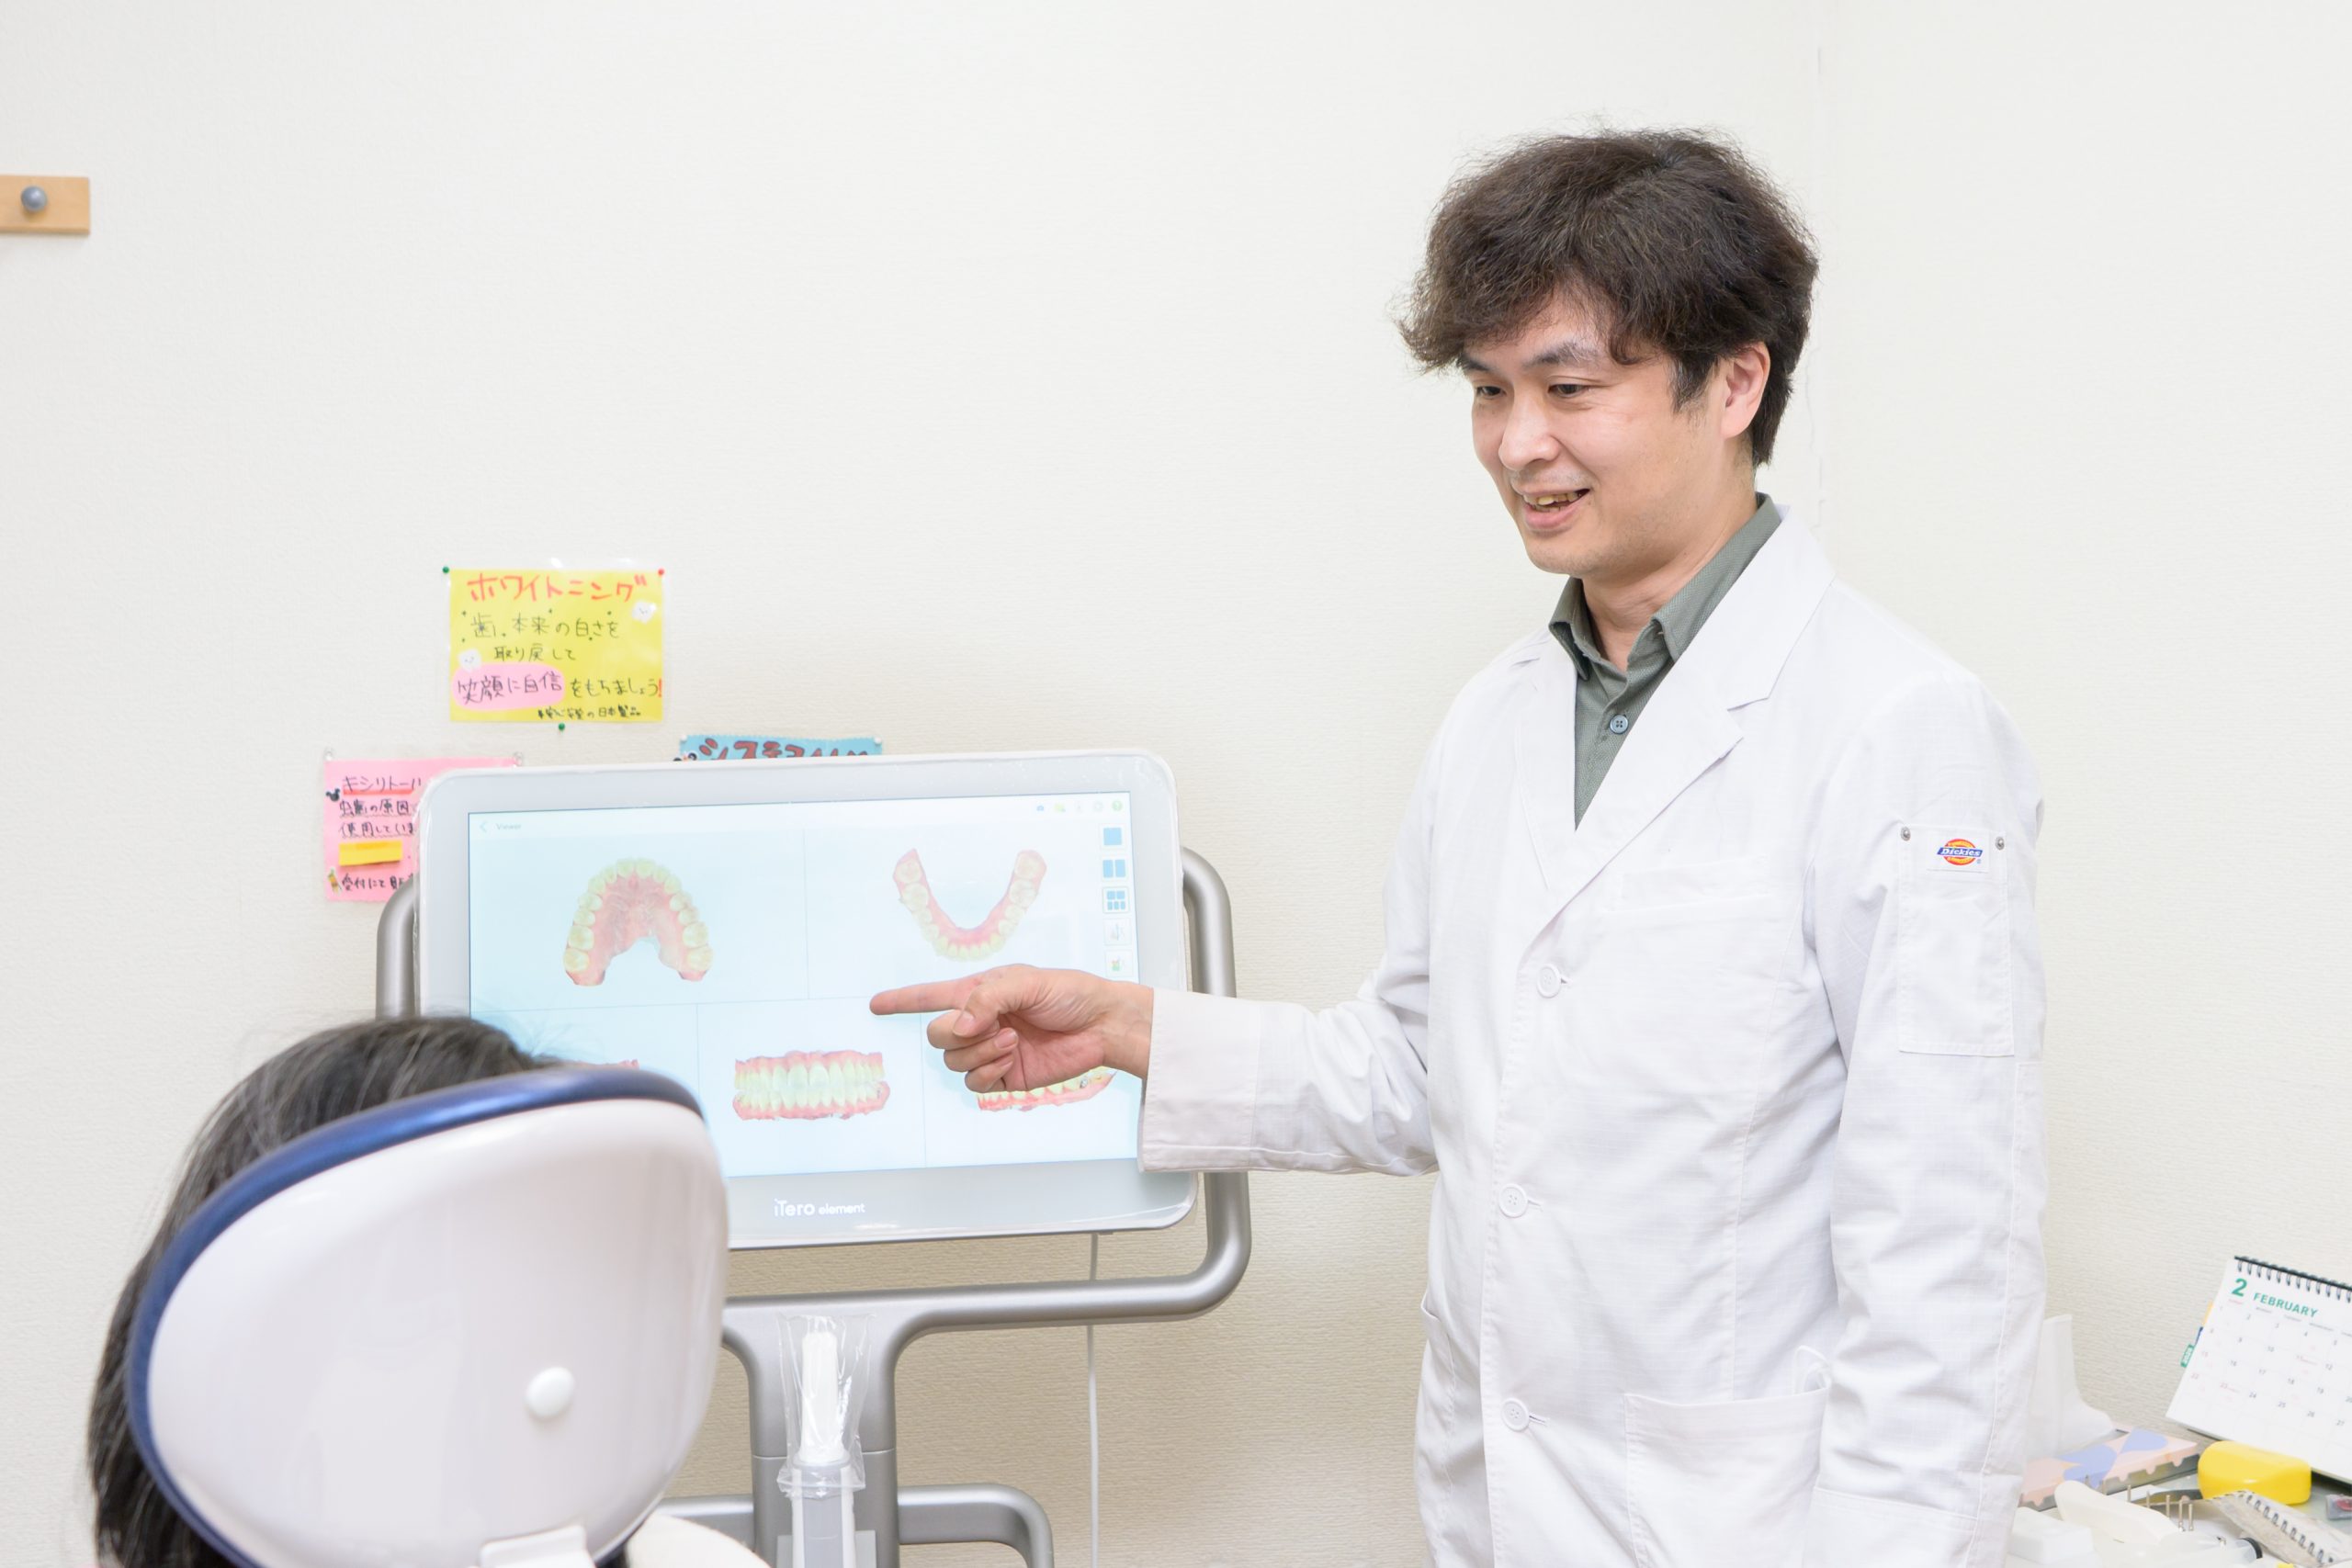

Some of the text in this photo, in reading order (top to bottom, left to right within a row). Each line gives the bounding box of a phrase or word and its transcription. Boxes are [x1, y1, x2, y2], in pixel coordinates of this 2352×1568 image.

[467, 573, 648, 602] ホワイトニング
[493, 643, 577, 661] 取り戻して
[339, 799, 417, 818] 虫歯の原因
[1940, 847, 1981, 857] Dickies
[341, 873, 414, 891] 受付にて販
[774, 1198, 865, 1217] iTero element
[2231, 1278, 2319, 1318] 2 FEBRUARY
